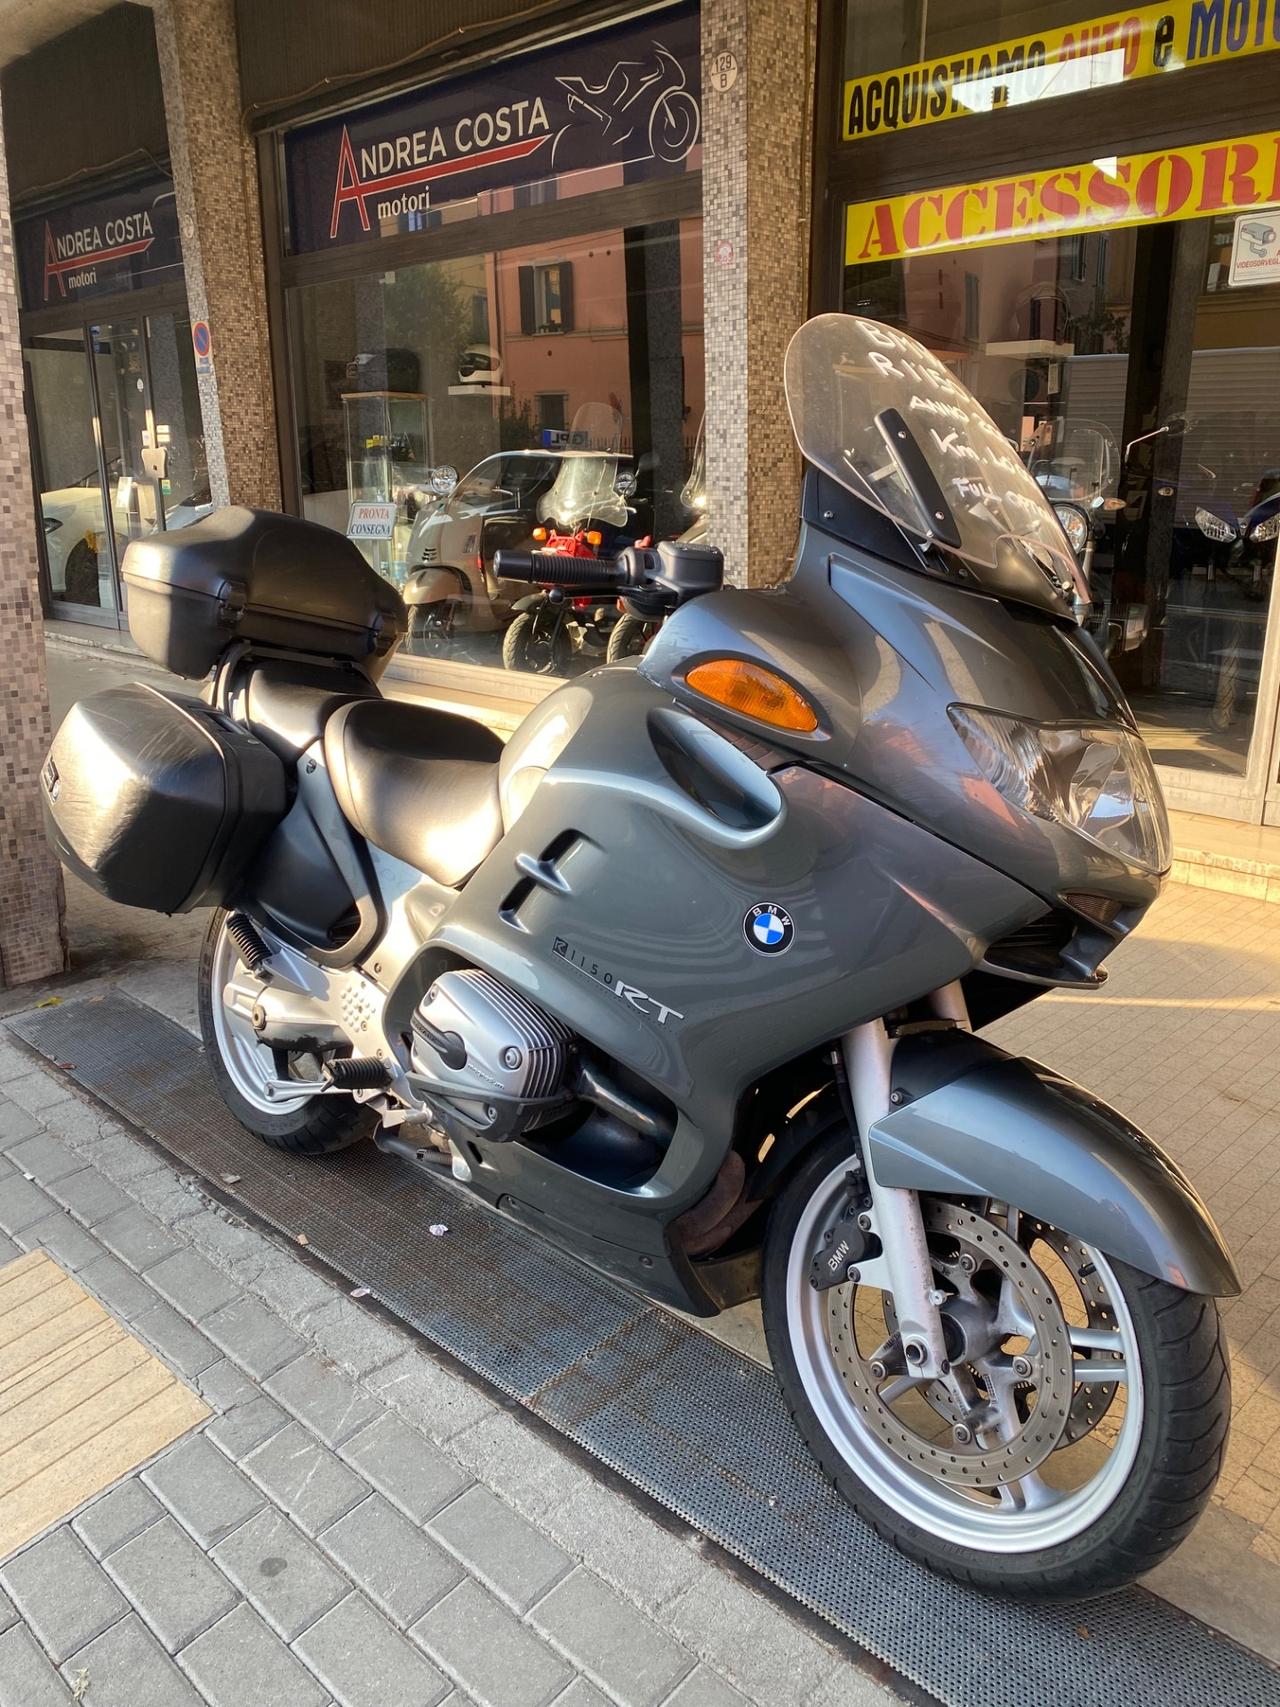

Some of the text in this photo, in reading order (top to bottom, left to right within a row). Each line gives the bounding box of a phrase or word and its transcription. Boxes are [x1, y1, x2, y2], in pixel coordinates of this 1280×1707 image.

[714, 54, 732, 73] 129
[848, 40, 1046, 134] ACQUISTIAMO
[1153, 15, 1174, 67] e
[330, 97, 550, 239] ANDREA COSTA
[377, 185, 431, 220] motori
[44, 211, 154, 301] ANDREA COSTA
[68, 267, 98, 290] motori
[350, 523, 391, 535] CONSEGNA
[358, 507, 390, 520] PRONTA
[827, 1239, 850, 1272] BMW
